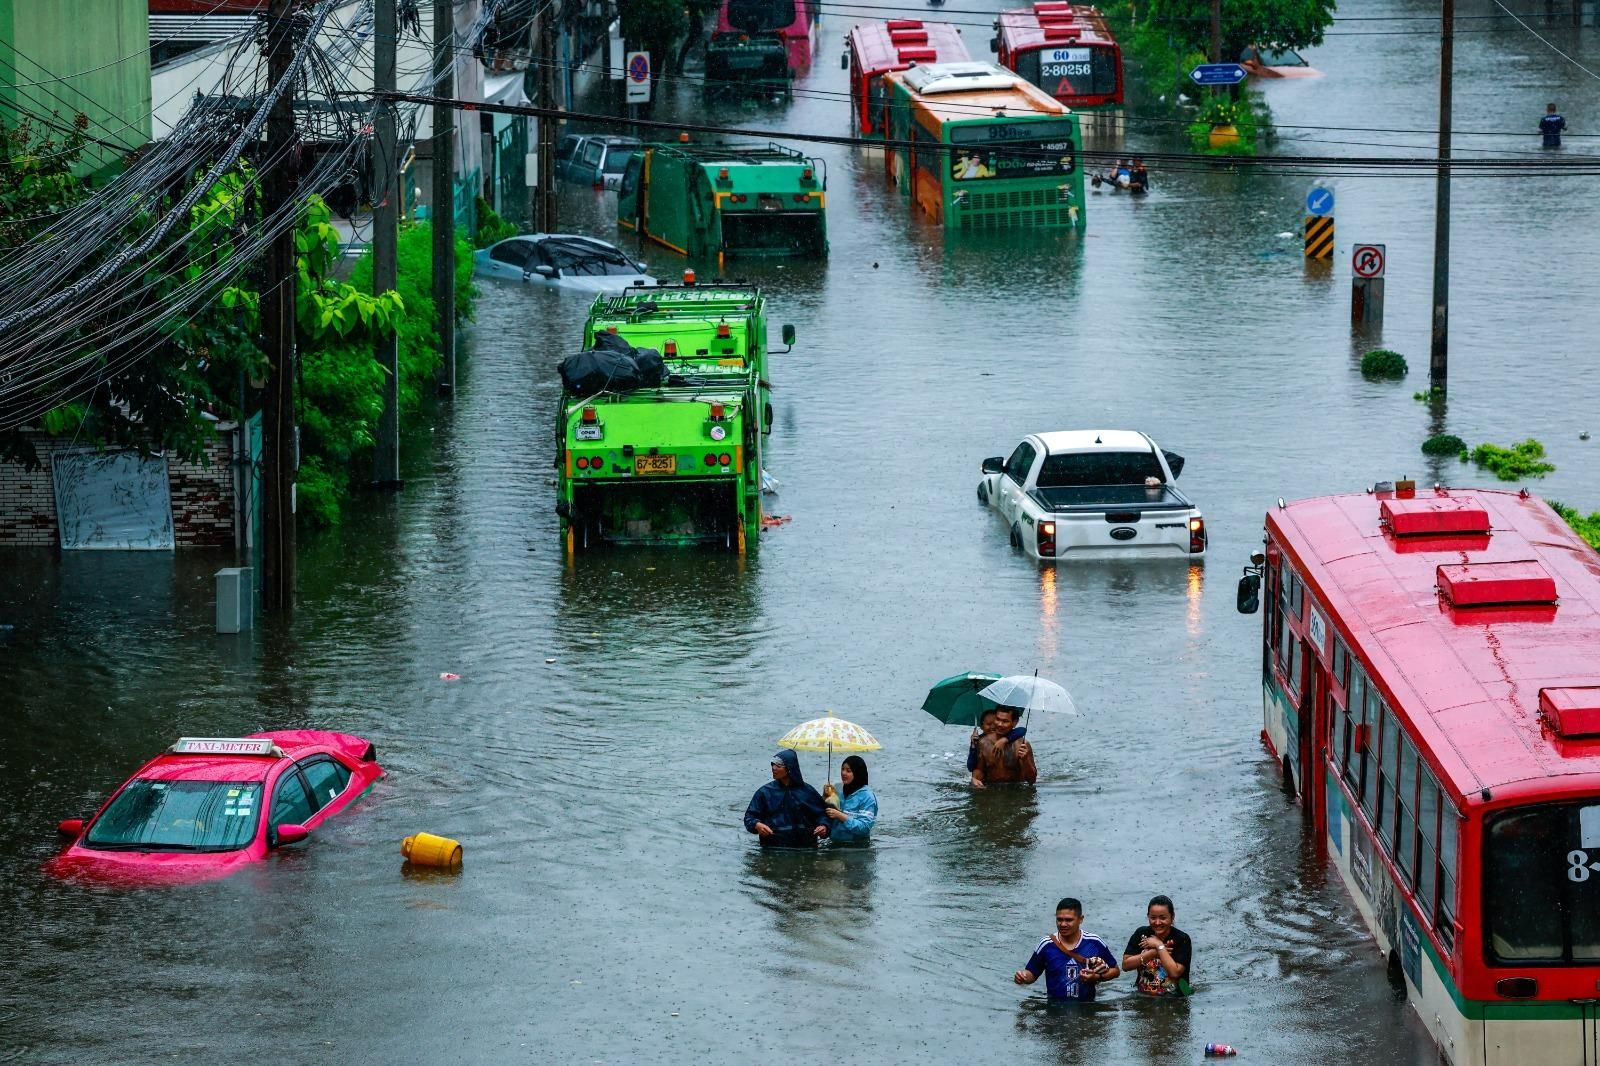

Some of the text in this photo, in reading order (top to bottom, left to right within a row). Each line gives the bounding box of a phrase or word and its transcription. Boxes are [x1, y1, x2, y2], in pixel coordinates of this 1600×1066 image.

[1053, 50, 1069, 61] 60
[1042, 63, 1091, 76] 2-80256
[637, 458, 674, 470] 67-8251
[187, 742, 261, 752] TAXI-METER
